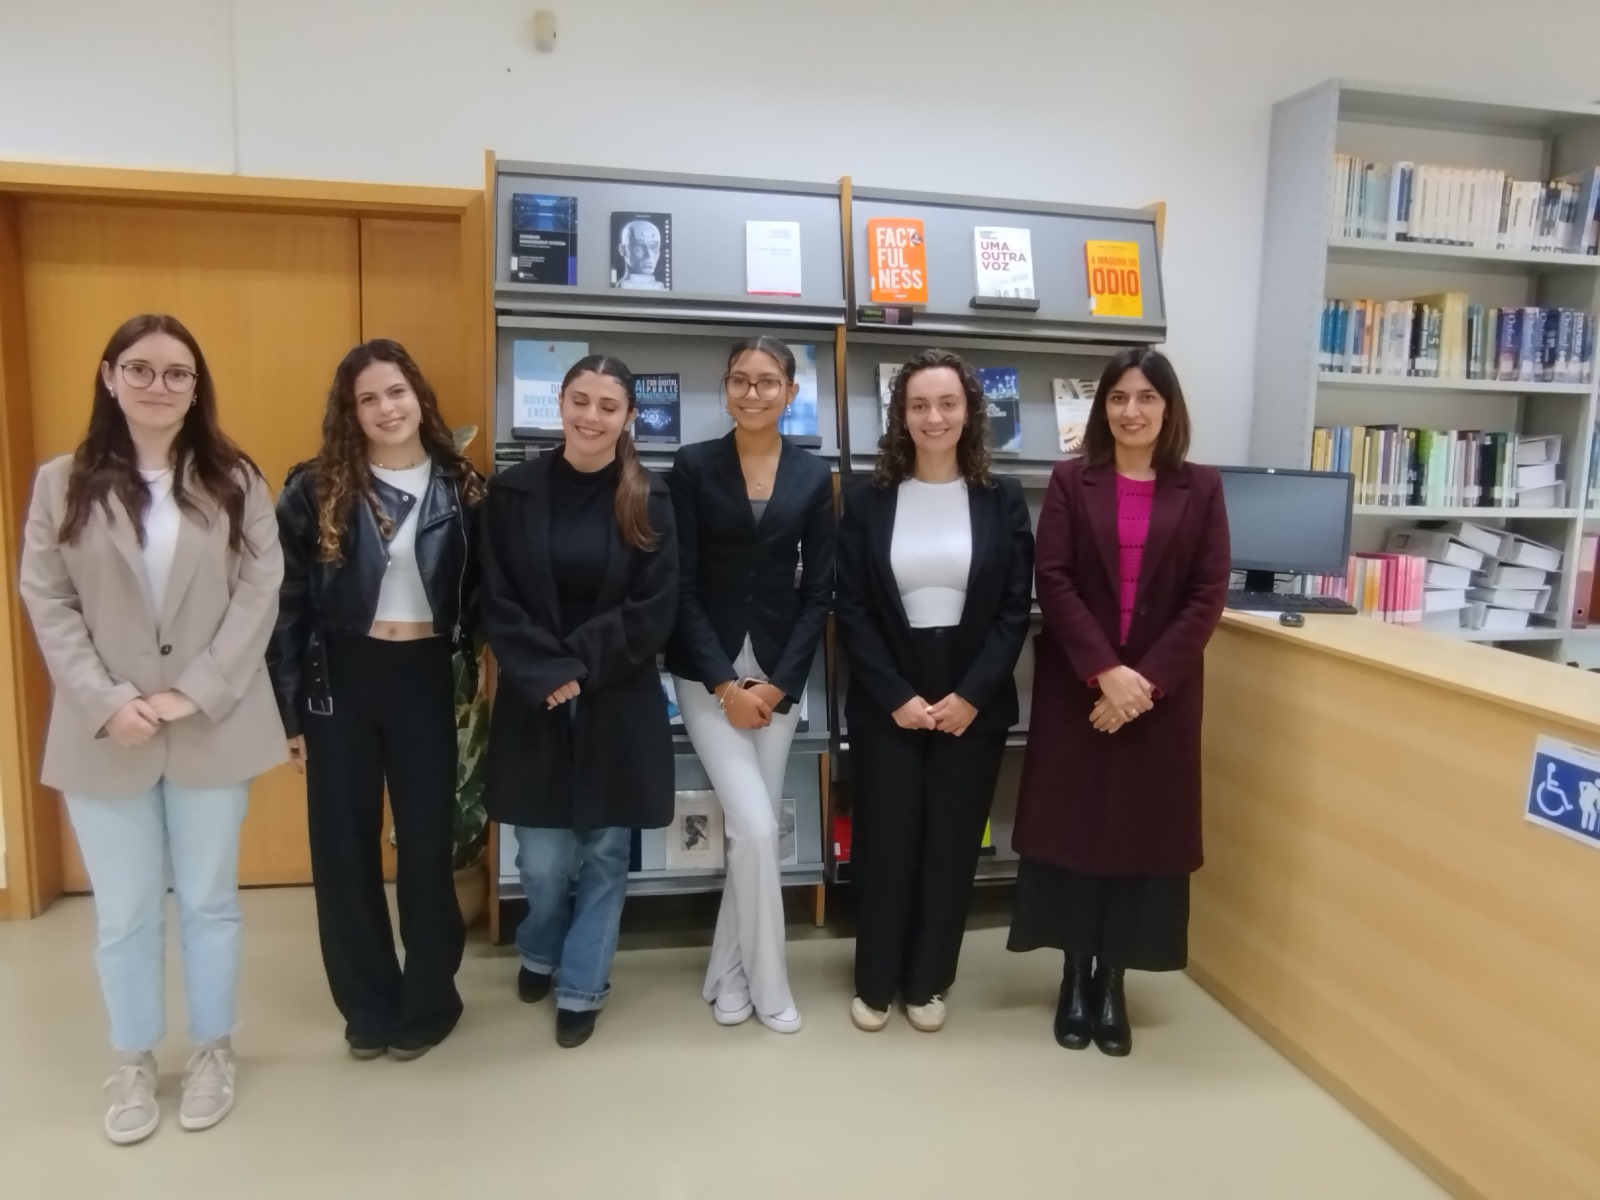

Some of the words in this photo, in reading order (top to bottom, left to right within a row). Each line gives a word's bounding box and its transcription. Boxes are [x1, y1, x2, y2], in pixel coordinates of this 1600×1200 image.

[876, 227, 918, 248] FACT
[981, 241, 1009, 251] UMA
[877, 248, 908, 268] FUL
[981, 251, 1026, 262] OUTRA
[982, 261, 1010, 272] VOZ
[878, 269, 923, 290] NESS
[635, 380, 645, 393] AI
[524, 396, 560, 405] GOVERN
[528, 408, 562, 417] EXCELL
